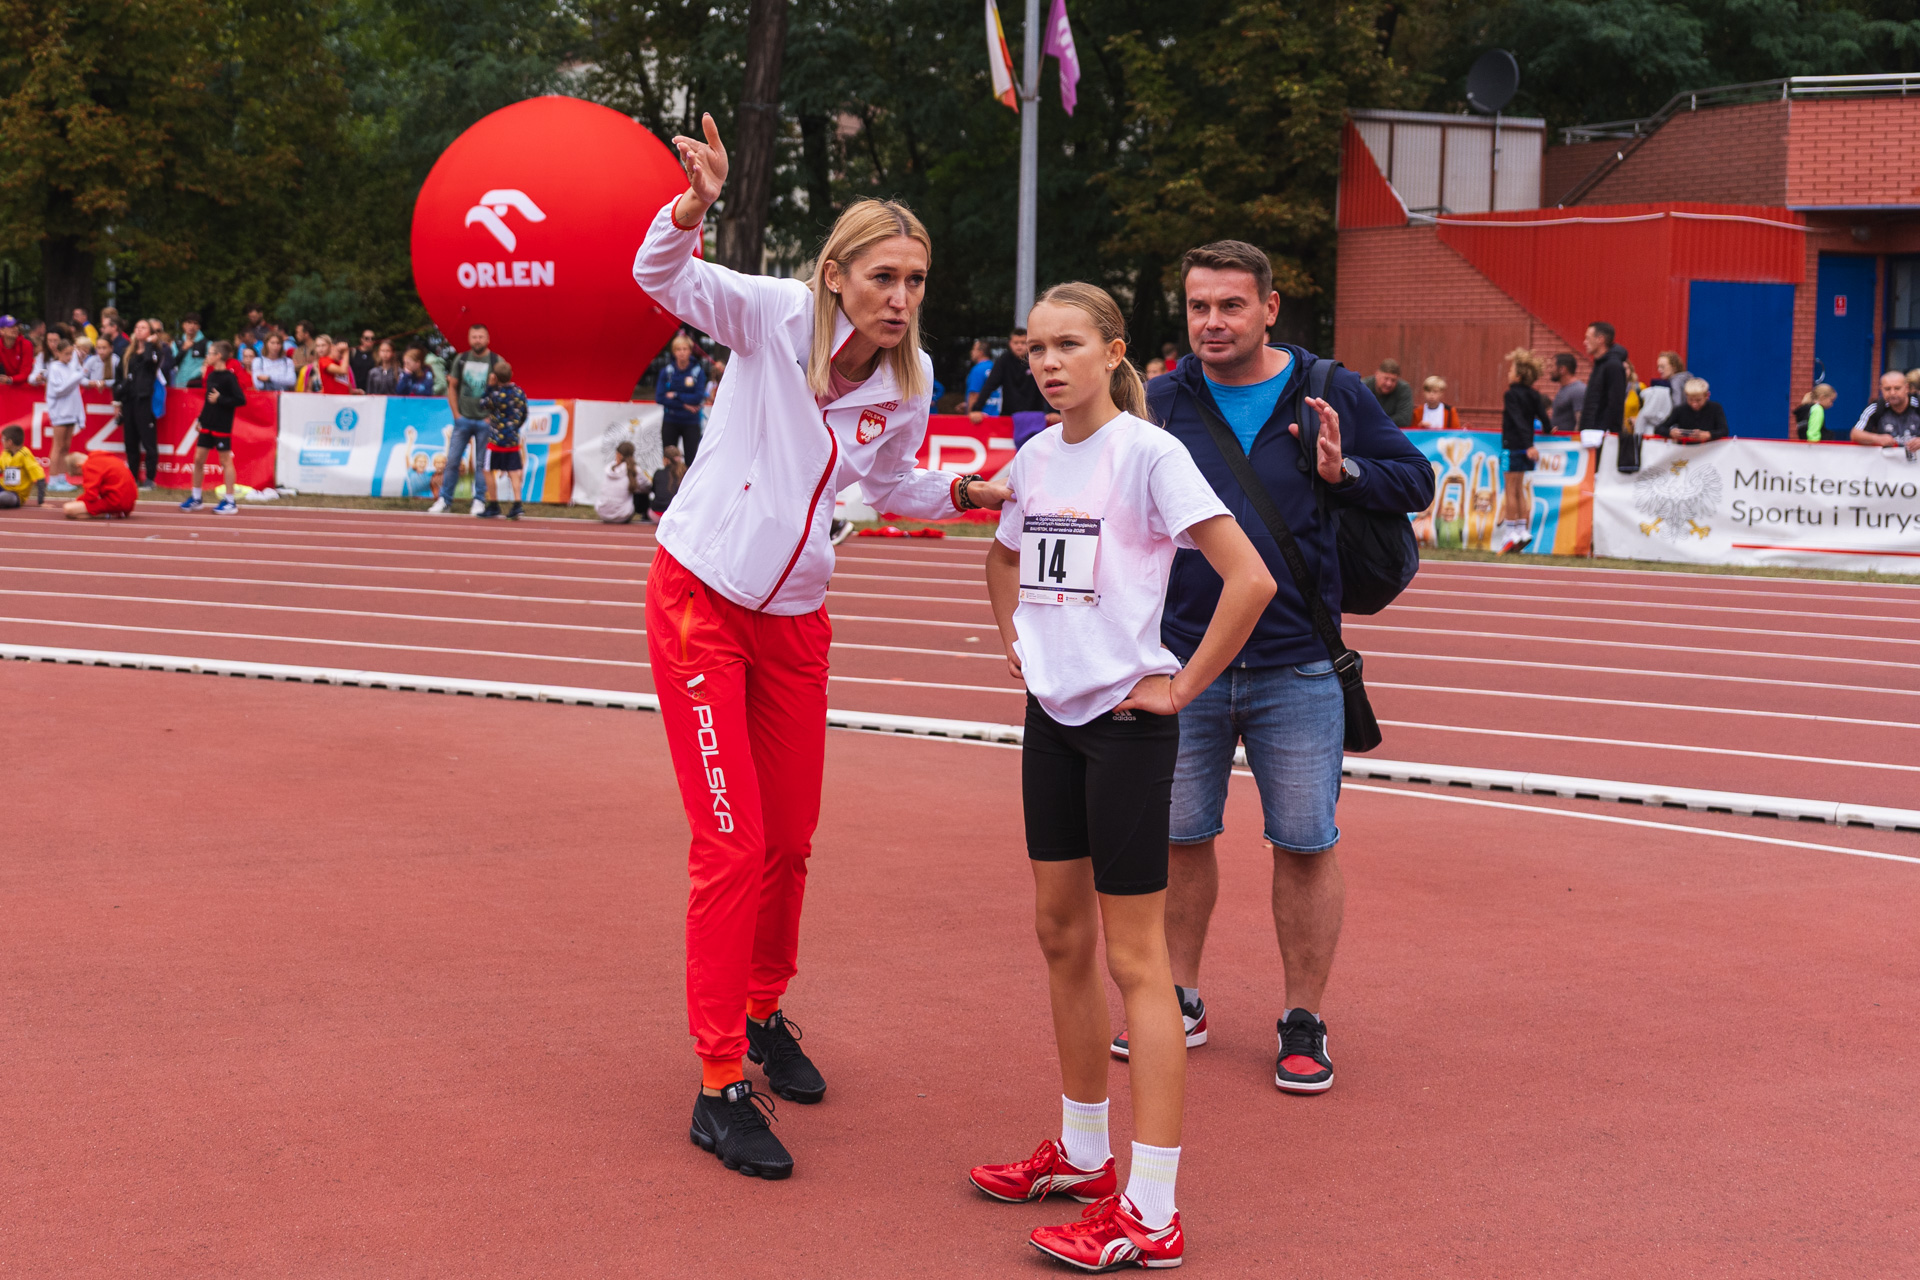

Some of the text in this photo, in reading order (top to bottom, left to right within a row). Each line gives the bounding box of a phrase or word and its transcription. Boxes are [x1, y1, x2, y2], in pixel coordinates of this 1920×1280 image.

[456, 260, 555, 289] ORLEN
[863, 410, 885, 422] POLSKA
[1733, 467, 1918, 499] Ministerstwo
[1730, 499, 1823, 527] Sportu
[1832, 505, 1839, 526] i
[1037, 538, 1067, 583] 14
[692, 705, 735, 834] POLSKA
